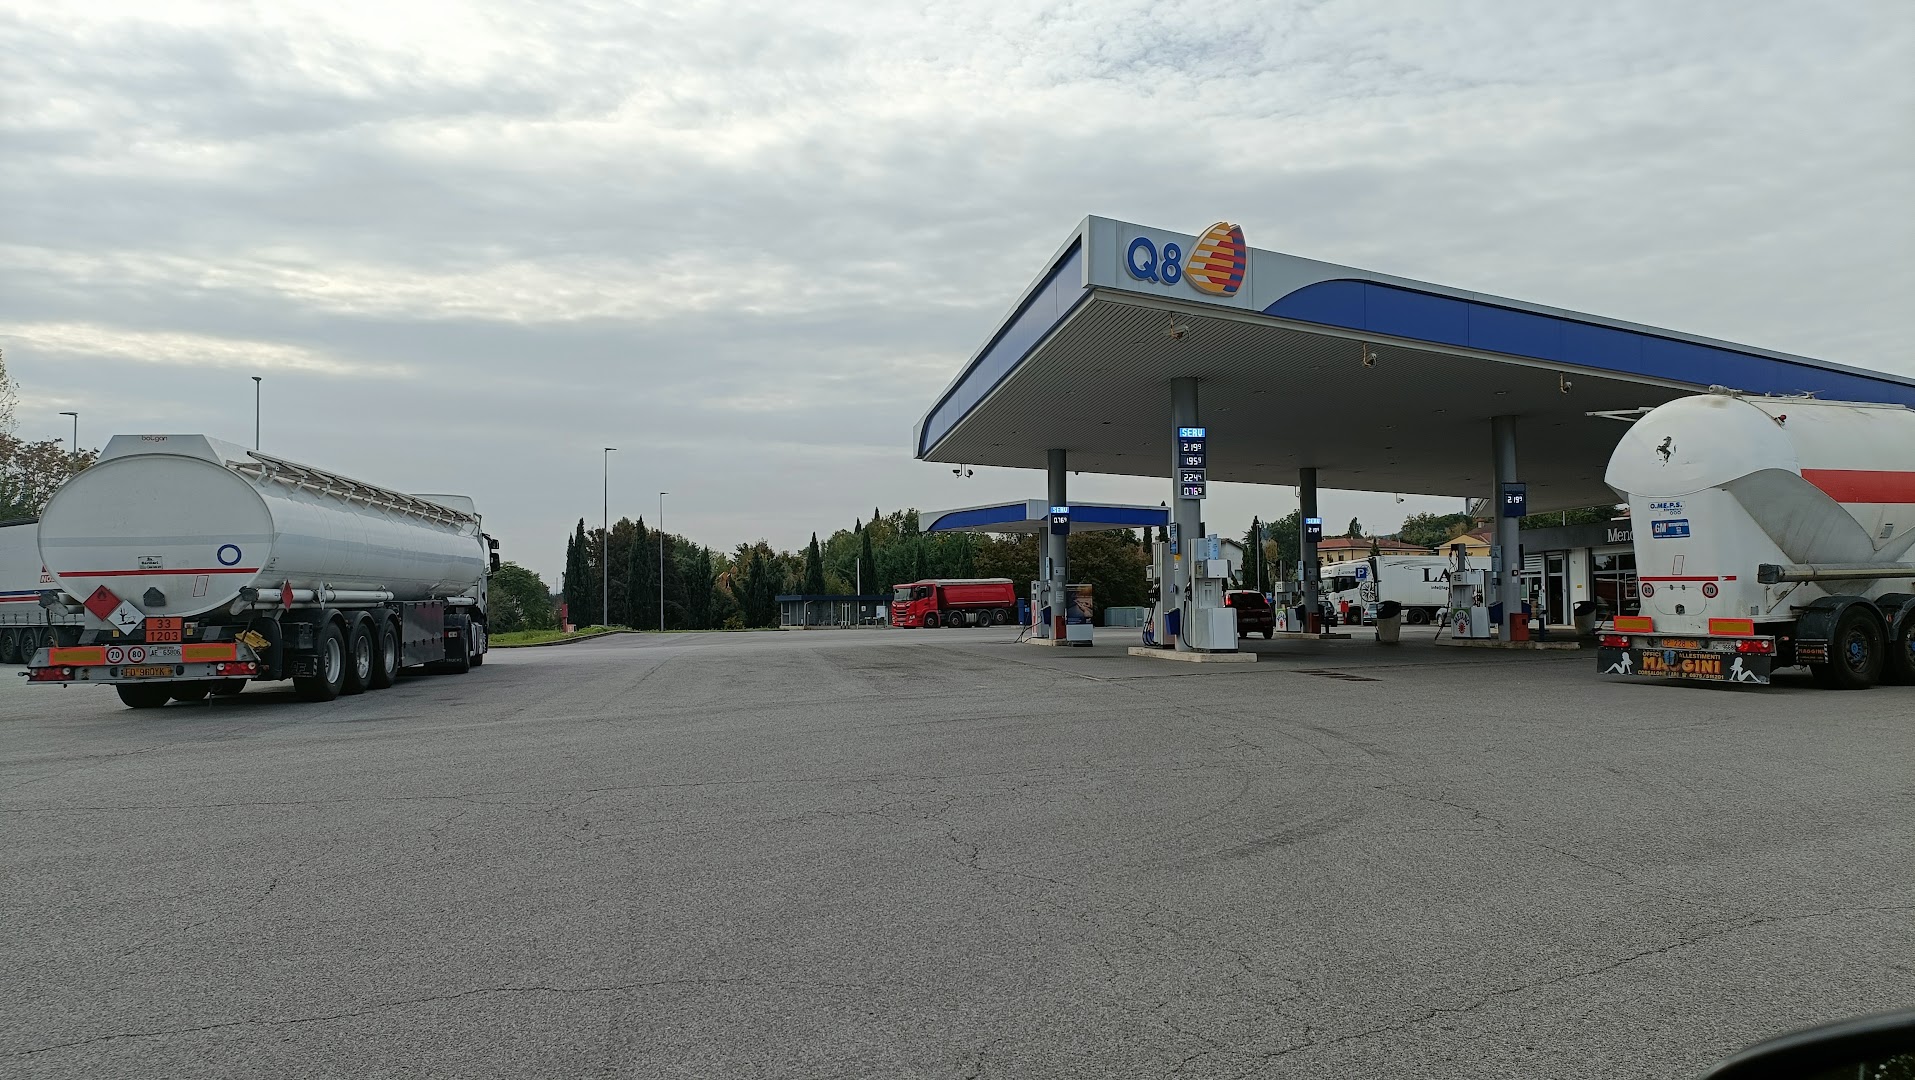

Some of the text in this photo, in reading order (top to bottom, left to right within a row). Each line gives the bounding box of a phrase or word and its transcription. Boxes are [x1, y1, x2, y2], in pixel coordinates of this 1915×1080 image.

[1124, 236, 1182, 286] Q8
[157, 619, 171, 629] 33
[150, 632, 178, 641] 1203
[110, 651, 120, 659] 70
[132, 650, 142, 658] 80
